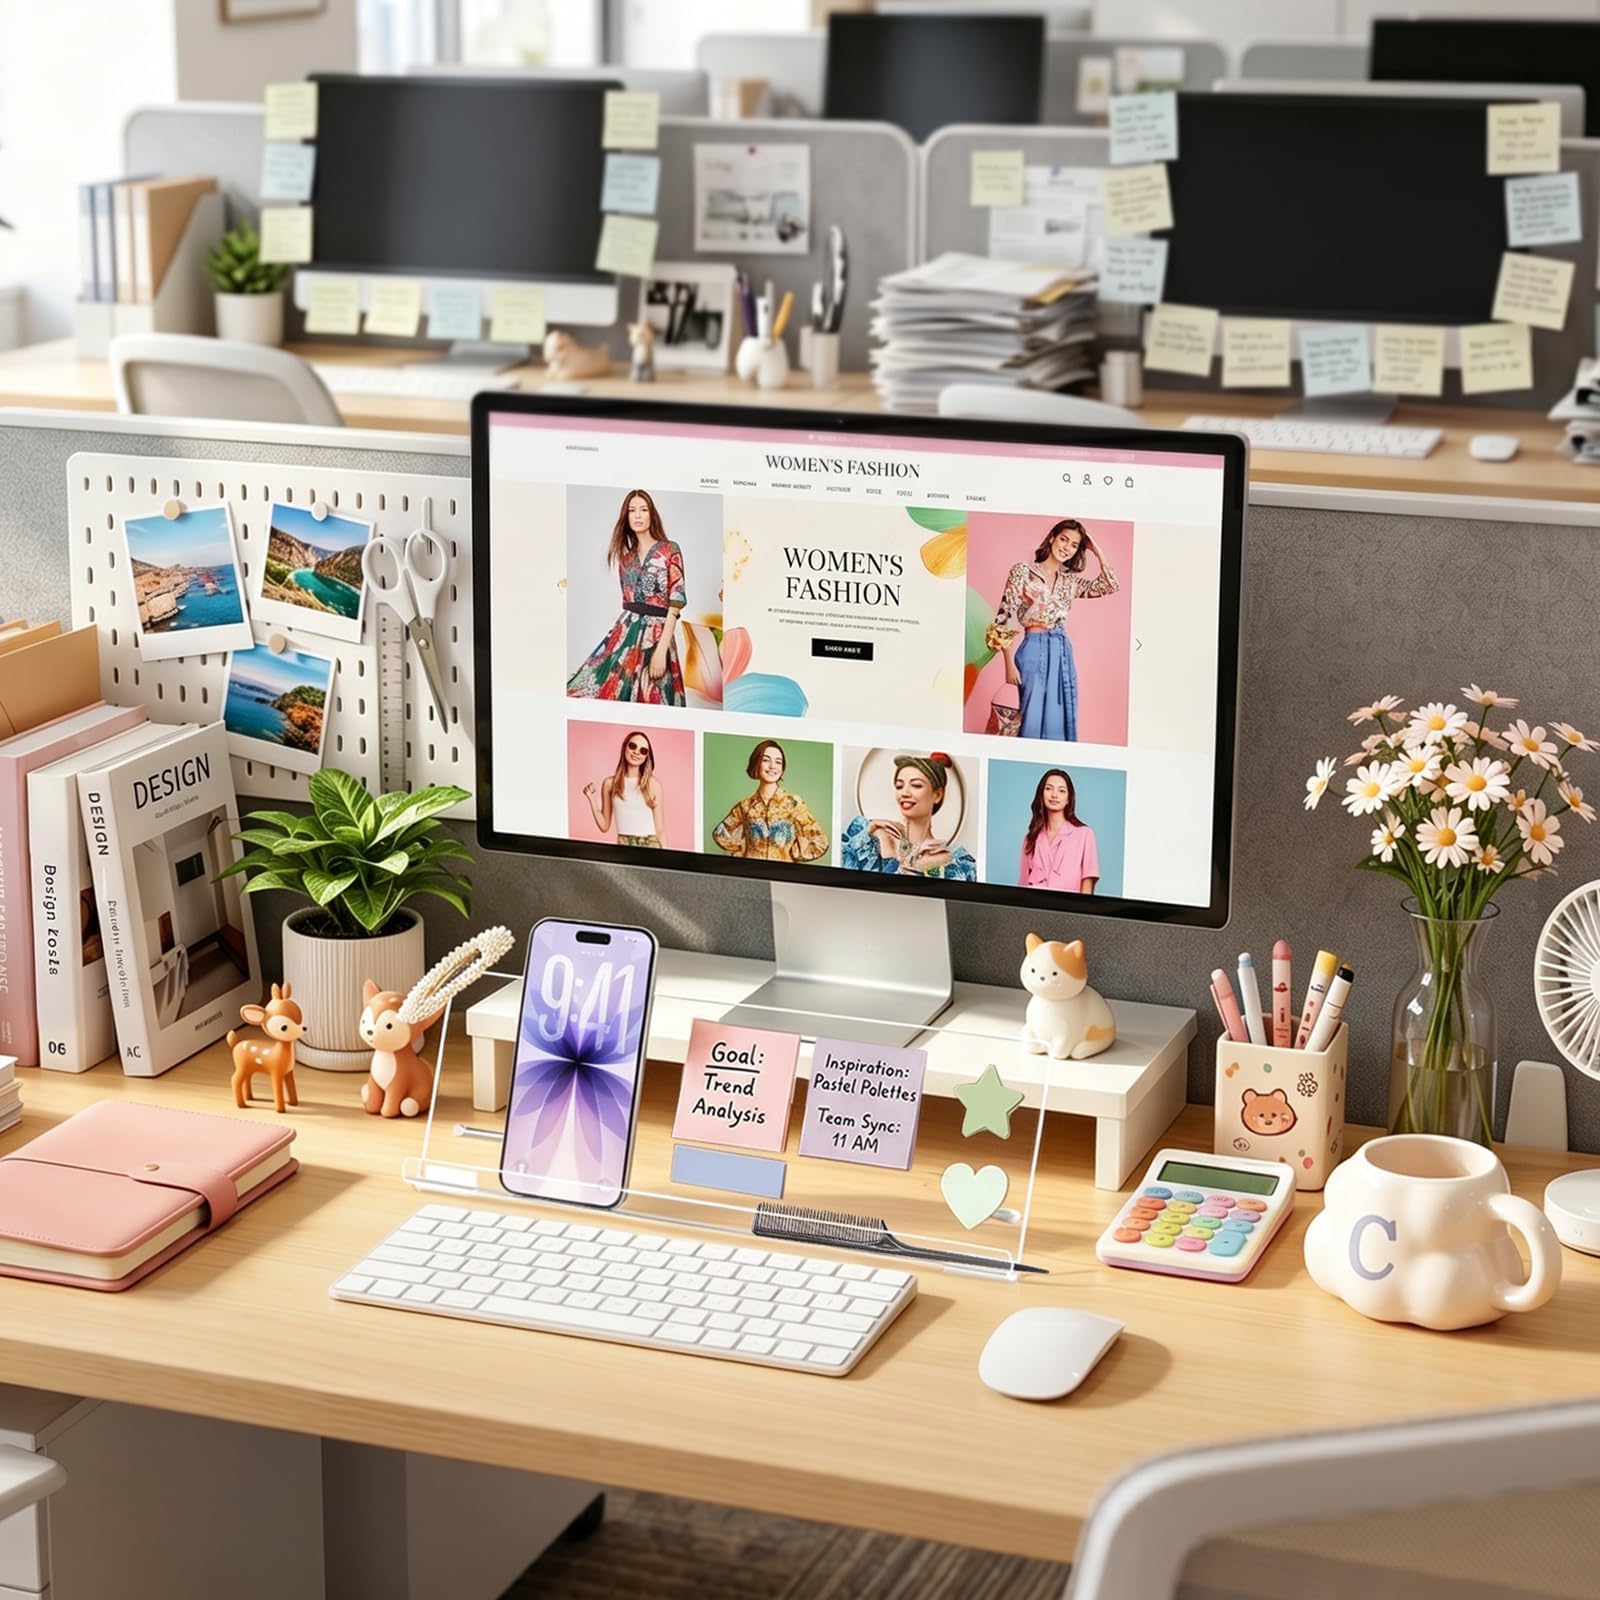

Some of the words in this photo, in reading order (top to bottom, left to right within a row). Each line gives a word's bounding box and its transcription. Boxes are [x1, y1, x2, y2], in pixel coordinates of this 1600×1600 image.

[765, 455, 843, 474] WOMEN'S
[847, 460, 921, 478] FASHION
[783, 547, 904, 577] WOMEN'S
[786, 576, 901, 606] FASHION
[133, 752, 210, 810] DESIGN
[88, 792, 109, 856] DESIGN
[538, 954, 635, 1054] 9:41
[48, 1041, 67, 1056] 06
[126, 1045, 142, 1059] AC
[711, 1041, 764, 1065] Goal:
[825, 1053, 910, 1079] Inspiration:
[703, 1072, 756, 1097] Trend
[813, 1072, 857, 1094] Pastel
[860, 1079, 917, 1103] Palettes
[691, 1097, 766, 1129] Analysis
[817, 1107, 856, 1128] Team
[861, 1113, 902, 1136] Sync:
[832, 1132, 847, 1148] 11
[851, 1135, 879, 1154] AM
[1347, 1213, 1397, 1281] C
